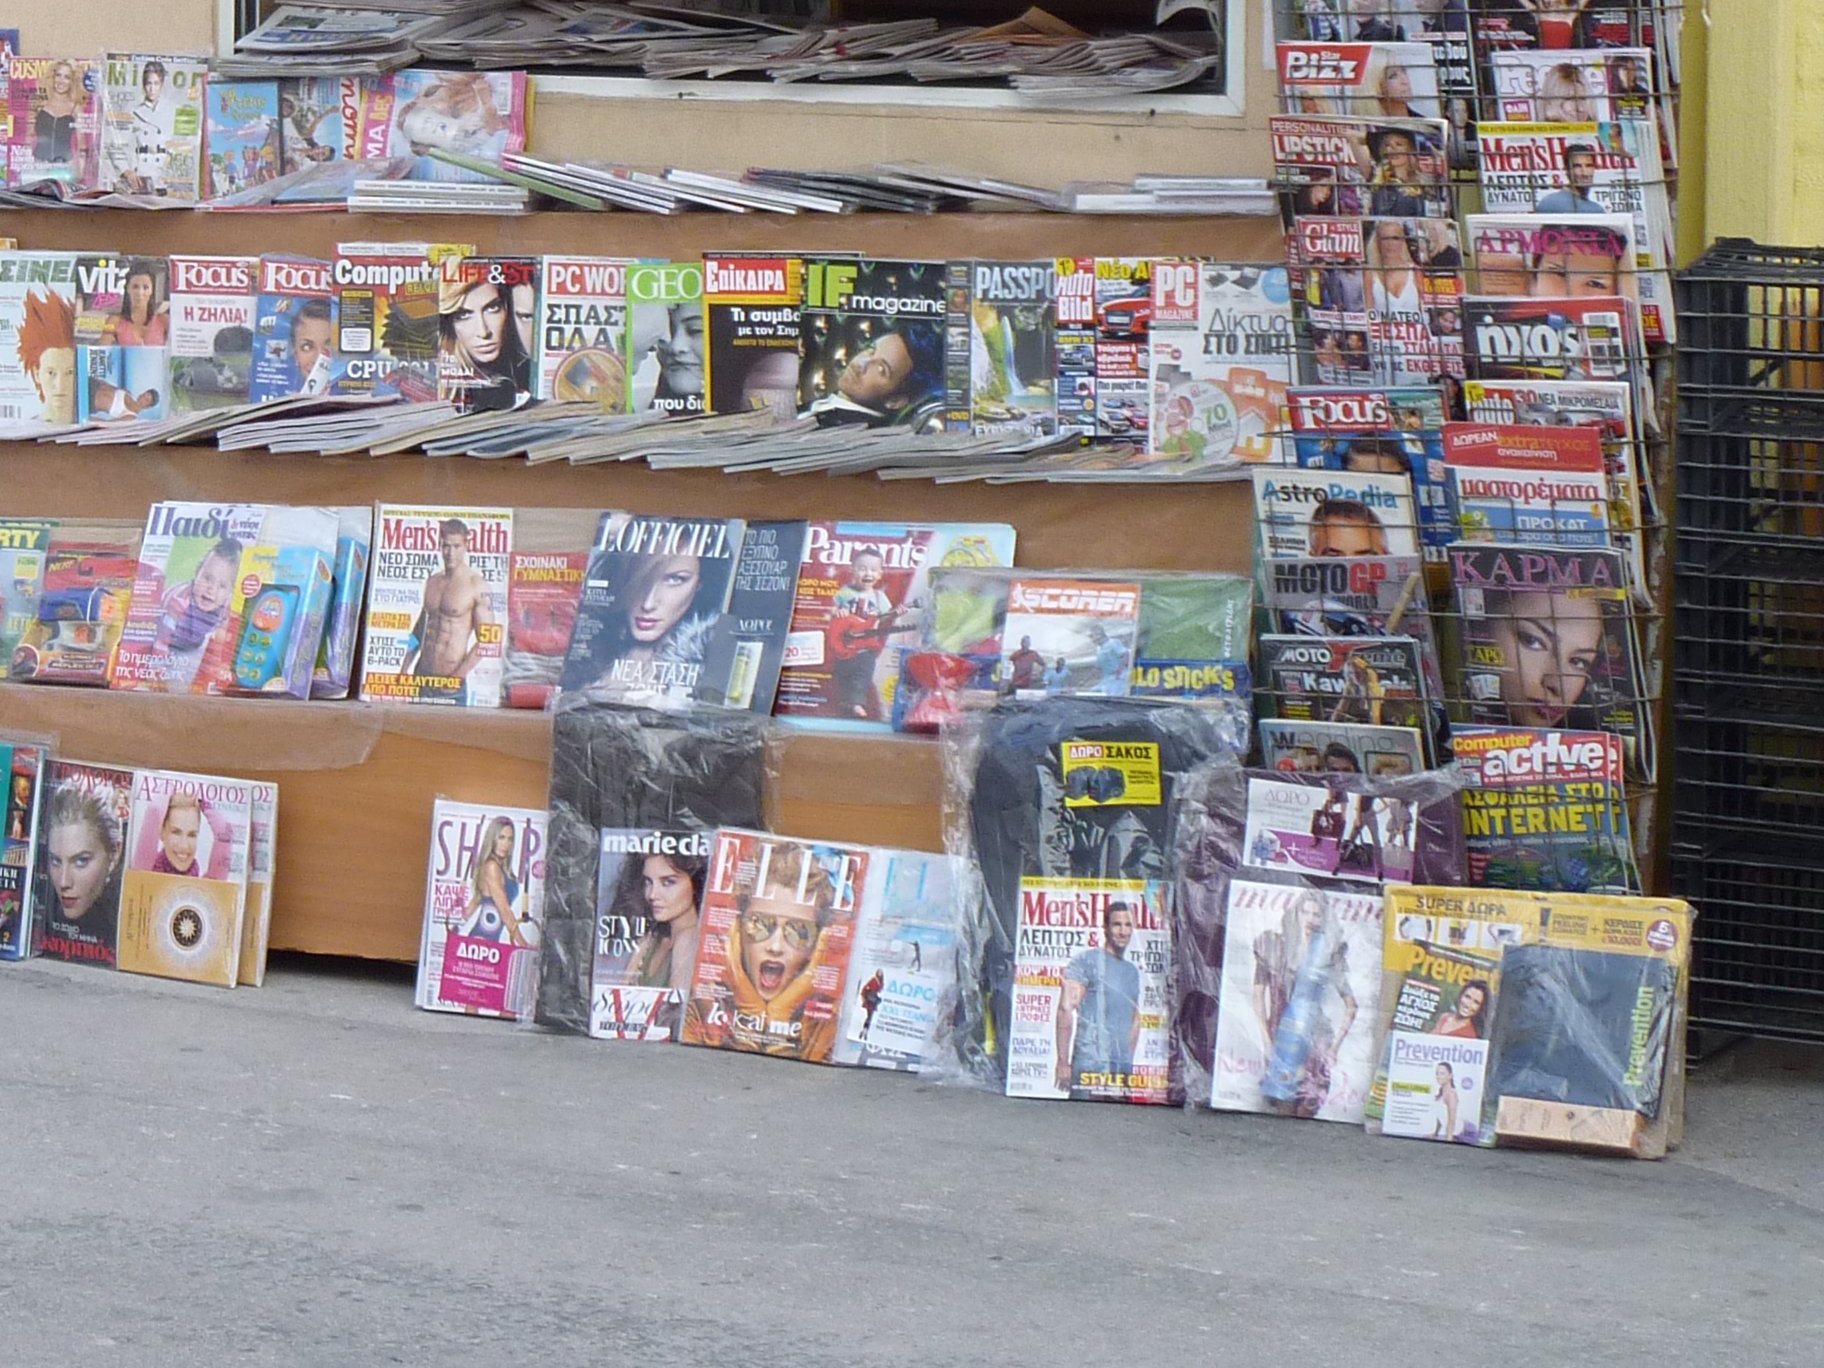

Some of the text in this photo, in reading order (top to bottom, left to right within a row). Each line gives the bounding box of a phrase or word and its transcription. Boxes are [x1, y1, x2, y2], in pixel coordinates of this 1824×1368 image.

[1481, 137, 1546, 171] Men's
[176, 260, 250, 291] Focus
[550, 265, 581, 293] PC
[631, 269, 702, 299] GEO
[1155, 265, 1194, 307] PC
[807, 264, 858, 309] IF
[199, 307, 247, 323] ΖΗΛΙΑ!
[731, 307, 747, 322] Τι
[1058, 296, 1094, 321] Bild
[1209, 307, 1287, 332] Δίκτυα
[1203, 334, 1239, 355] ΣΤΟ
[1296, 393, 1388, 430] Focus
[1453, 432, 1498, 446] ΔΩΡΕΑΝ
[1262, 480, 1398, 509] AstroPedia
[380, 518, 437, 550] Men's
[802, 526, 931, 570] Parents
[379, 552, 439, 566] ΝΕΟ ΣΩΜΑ
[515, 555, 567, 569] ΣΧΟΙΝΑΚΙ
[738, 560, 788, 575] ΑΞΕΣΟΥΑΡ
[377, 565, 410, 578] ΝΕΟΣ
[1454, 551, 1615, 589] ΚΑΡΜΑ
[754, 576, 790, 592] ΣΕΖΟΝ!
[479, 625, 502, 642] 50
[119, 650, 129, 661] Το
[399, 674, 461, 688] ΚΑΛΥΤΕΡΟΣ
[612, 659, 701, 686] ΝΕΑ ΣΤΑΣΗ
[1164, 665, 1235, 691] STICKS
[1070, 744, 1152, 760] ΔΩΡΟ ΣΑΚΟΣ
[1453, 734, 1532, 751] Computer
[136, 776, 248, 805] ΑΣΤΡΟΛΟΓΟΣ
[604, 833, 675, 854] marie
[711, 837, 863, 912] ELLE
[1021, 891, 1088, 927] Men's
[1416, 896, 1464, 911] SUPER
[2, 933, 10, 943] 2
[1020, 929, 1099, 947] ΛΕΠΤΟΣ &
[457, 942, 500, 963] ΔΩΡΟ
[1019, 945, 1072, 958] ΔΥΝΑΤΟΣ
[1016, 993, 1051, 1005] SUPER
[770, 1020, 802, 1037] me
[1623, 985, 1654, 1086] Prevention
[1395, 1039, 1483, 1065] Prevention
[1080, 1073, 1125, 1086] STYLE
